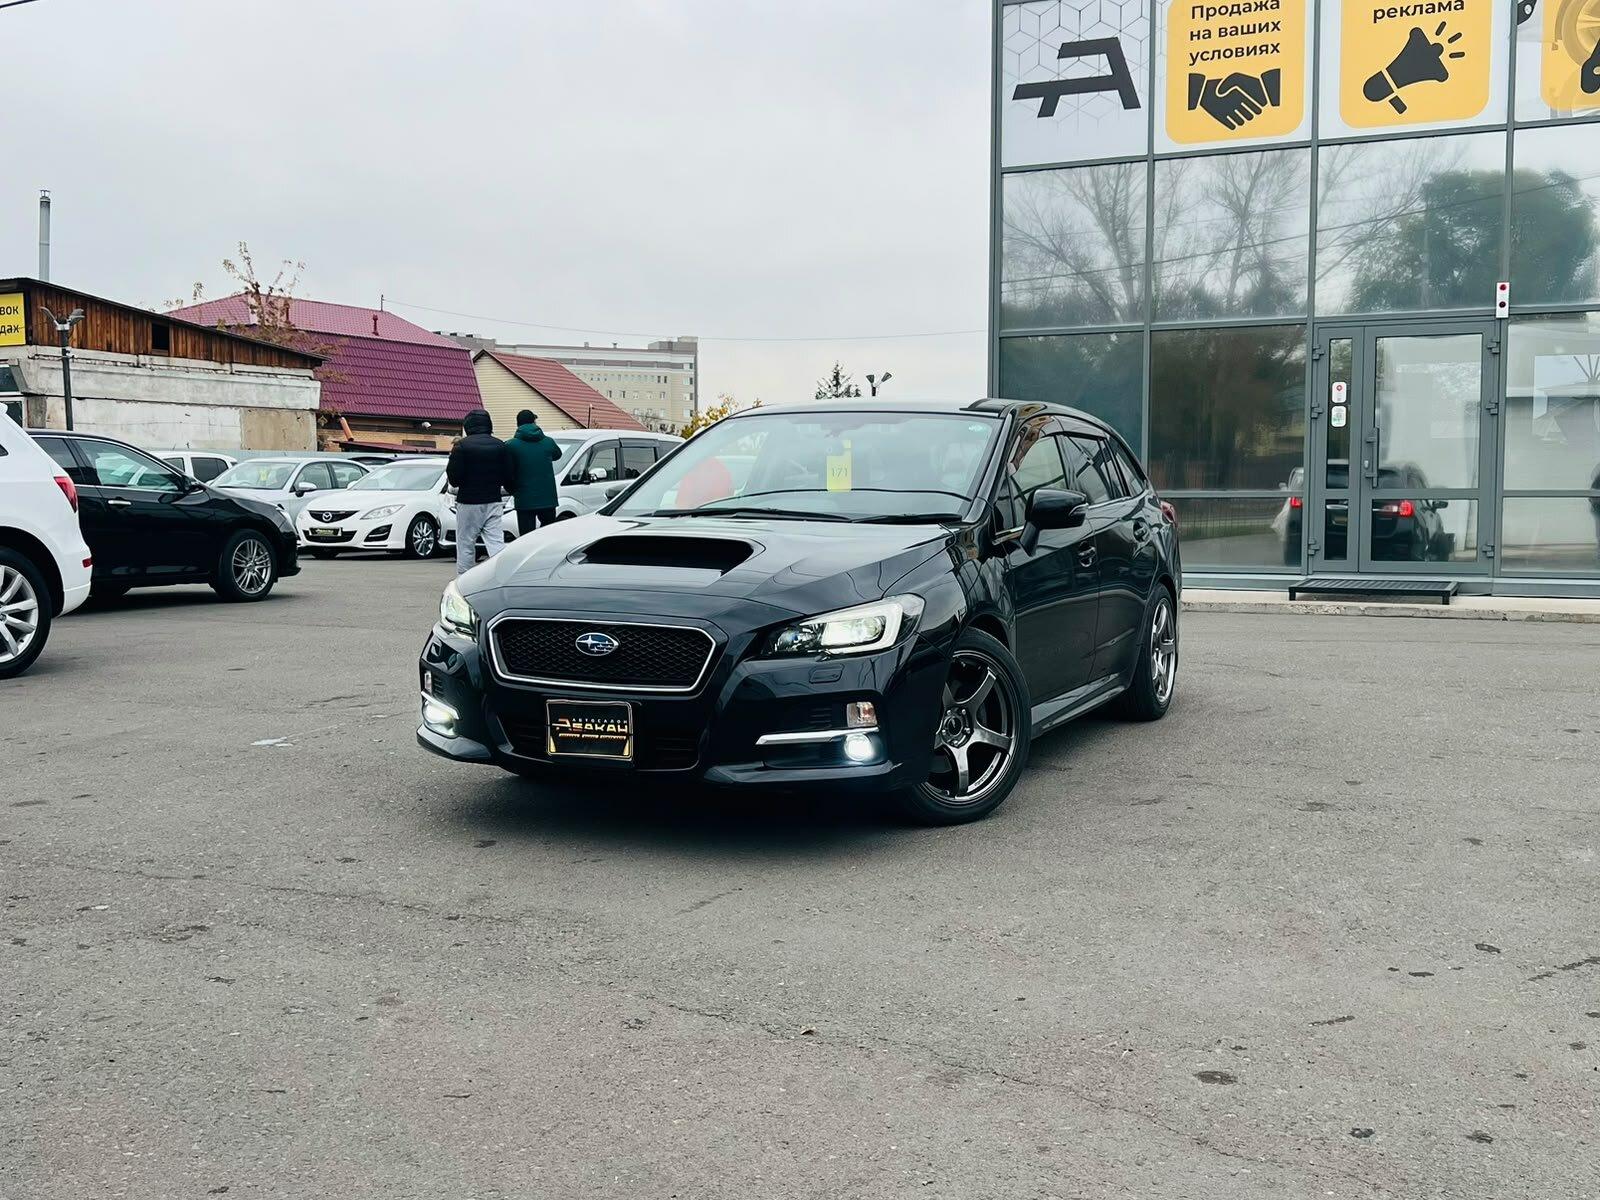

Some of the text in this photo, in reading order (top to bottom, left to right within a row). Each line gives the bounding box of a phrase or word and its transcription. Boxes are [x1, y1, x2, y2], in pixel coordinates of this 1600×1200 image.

[1191, 0, 1281, 21] Продажа
[1373, 0, 1465, 23] реклама
[1190, 20, 1281, 41] на ваших
[1189, 42, 1281, 66] условиях
